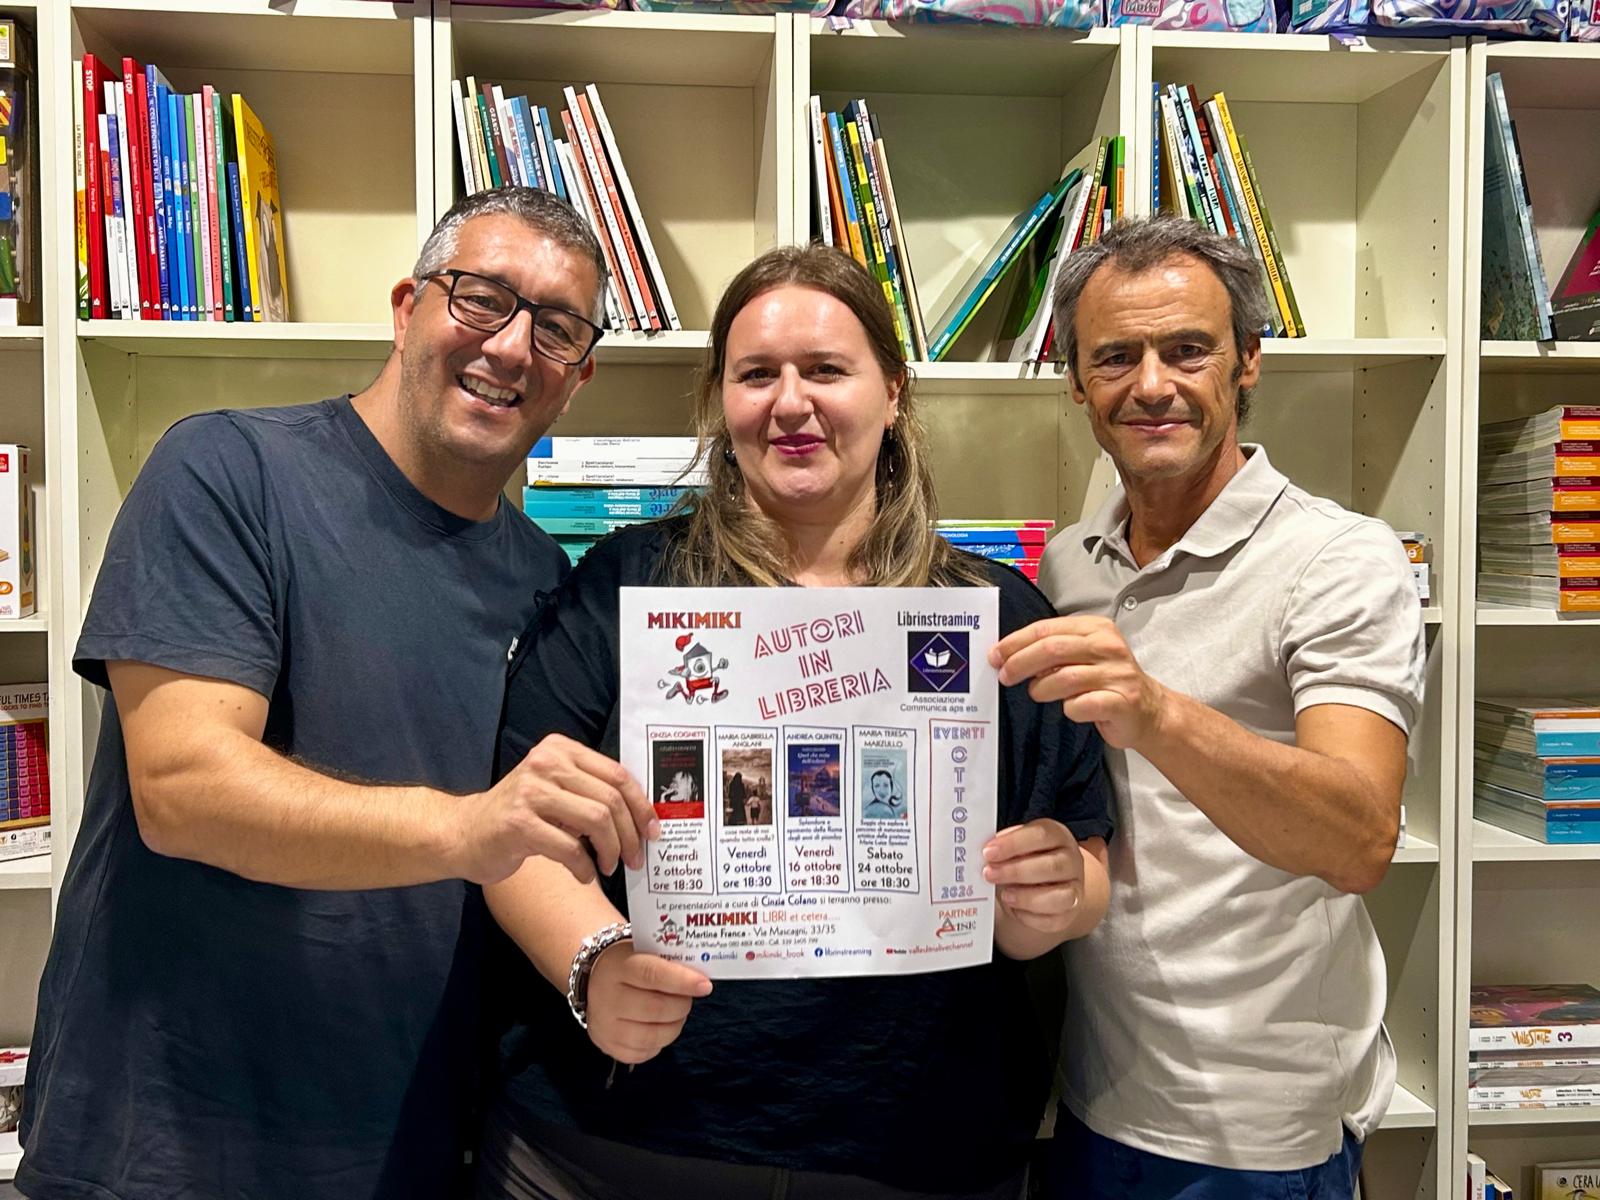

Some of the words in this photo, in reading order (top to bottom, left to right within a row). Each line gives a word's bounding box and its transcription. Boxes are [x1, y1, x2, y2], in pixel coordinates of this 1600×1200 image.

[85, 69, 93, 91] STOP
[125, 73, 133, 94] STOP
[647, 611, 741, 629] MIKIMIKI
[897, 610, 980, 630] Librinstreaming
[754, 610, 865, 659] AUTORI
[799, 650, 833, 679] IN
[15, 693, 41, 704] TIMES
[758, 668, 892, 720] LIBRERIA
[913, 695, 965, 704] Associazione
[900, 704, 947, 713] Communica
[949, 705, 964, 713] aps
[933, 727, 985, 739] EVENTI
[951, 746, 968, 882] OTTOBRE
[867, 847, 903, 860] Sabato
[654, 867, 660, 876] 2
[664, 864, 703, 877] ottobre
[723, 863, 730, 873] 9
[734, 860, 771, 873] ottobre
[789, 862, 800, 872] 16
[805, 858, 842, 872] ottobre
[858, 862, 871, 873] 24
[875, 861, 913, 874] ottobre
[653, 882, 670, 891] ore
[673, 878, 703, 890] 18:30
[723, 880, 741, 888] ore
[744, 876, 772, 887] 18:30
[791, 877, 808, 887] ore
[811, 875, 840, 886] 18:30
[861, 879, 878, 888] ore
[881, 877, 910, 889] 18:30
[941, 885, 974, 899] 2026
[656, 899, 667, 910] Le
[668, 900, 722, 911] presentazioni
[751, 897, 759, 907] di
[761, 896, 785, 907] Cinzia
[820, 896, 826, 904] si
[828, 896, 861, 904] terranno
[863, 896, 892, 905] presso:
[686, 911, 758, 927] MIKIMIKI
[762, 912, 787, 923] LIBRI
[789, 913, 798, 921] et
[938, 907, 978, 919] PARTNER
[685, 929, 718, 939] Martina
[720, 927, 746, 938] Franca
[753, 927, 767, 937] Via
[810, 924, 836, 934] 33/35
[1558, 1031, 1573, 1042] 3
